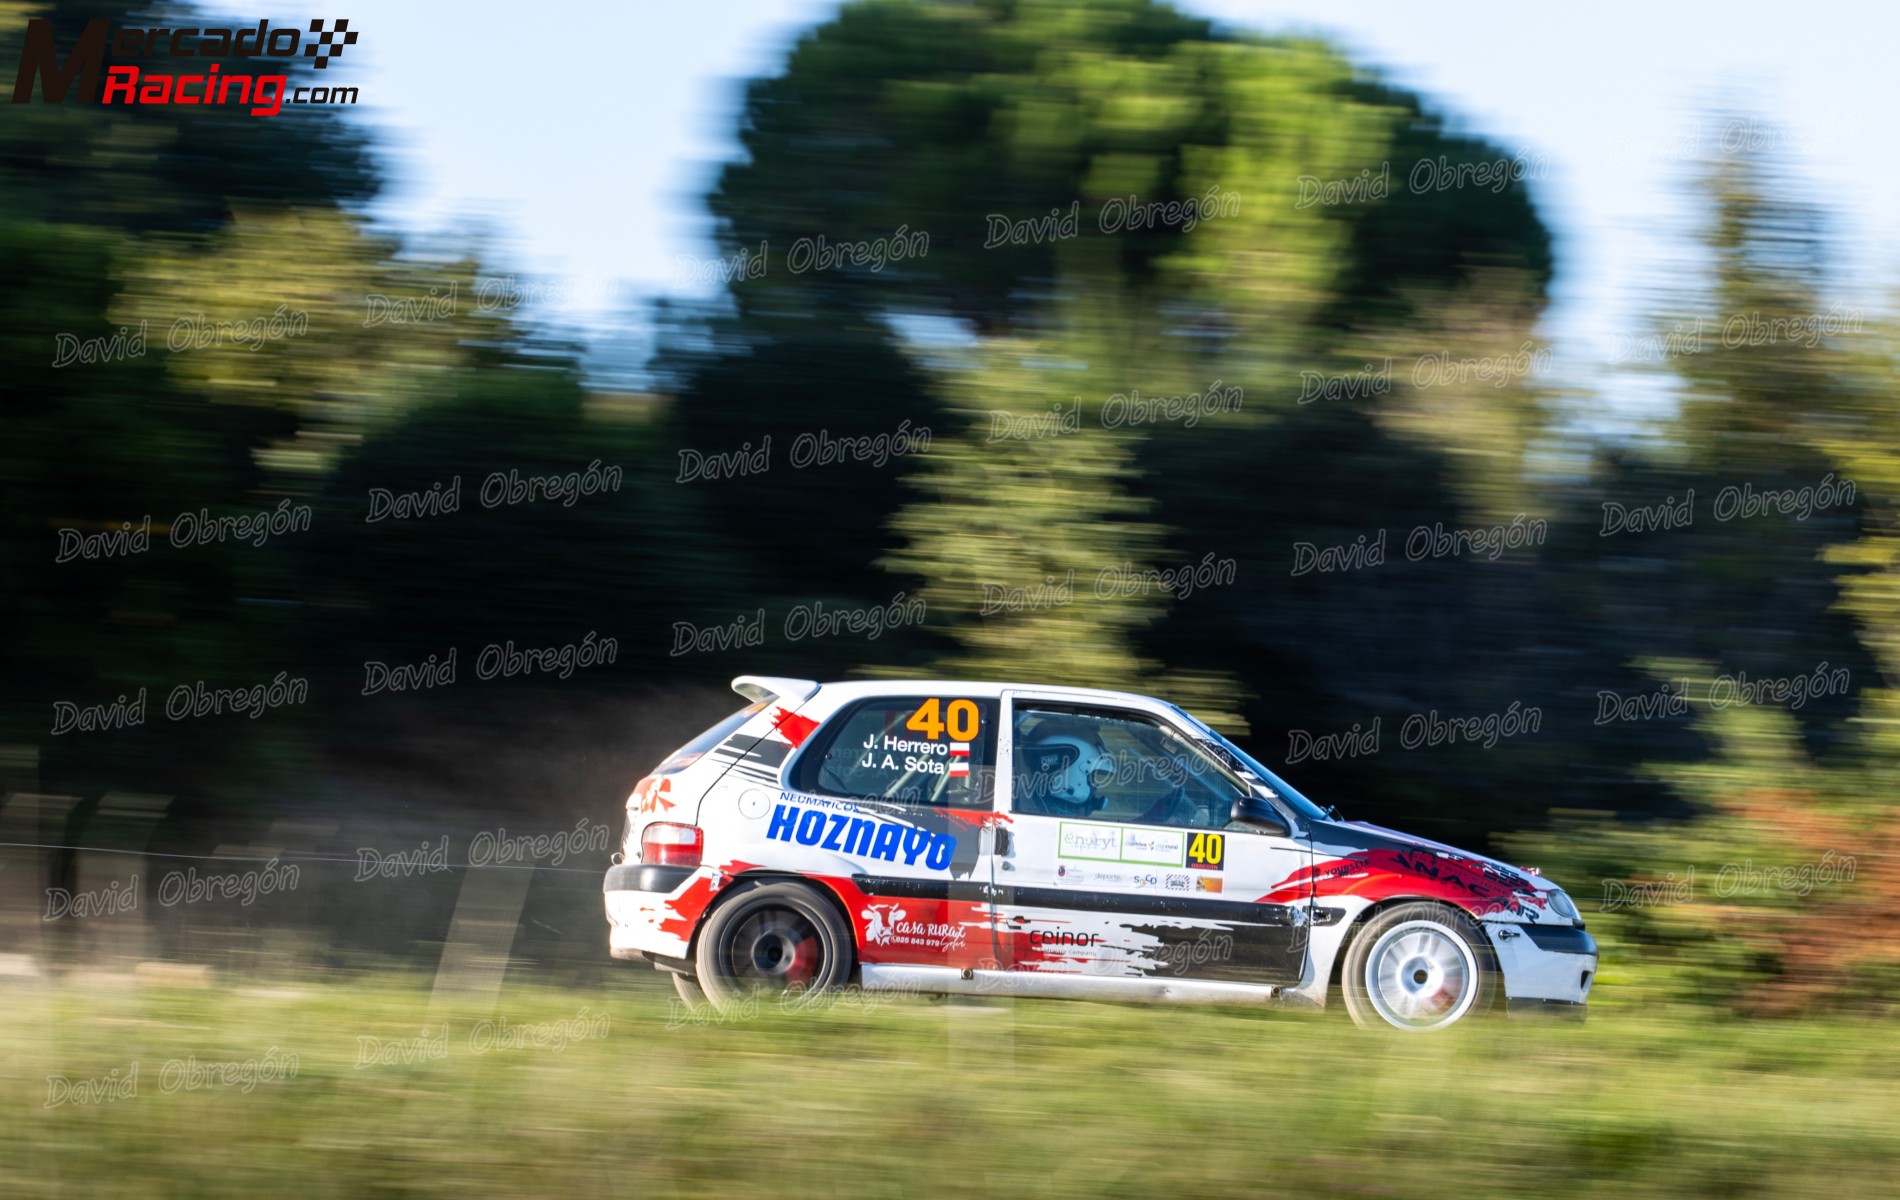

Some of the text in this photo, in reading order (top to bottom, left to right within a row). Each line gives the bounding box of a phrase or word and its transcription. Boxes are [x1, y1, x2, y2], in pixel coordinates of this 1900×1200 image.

[906, 698, 979, 742] 40
[863, 734, 878, 750] J.
[883, 735, 948, 756] Herrero
[862, 753, 878, 768] J.
[881, 755, 899, 772] A.
[904, 756, 945, 775] Sota
[767, 804, 957, 871] HOZNAYO
[1188, 833, 1223, 865] 40
[1029, 926, 1100, 947] ceinor
